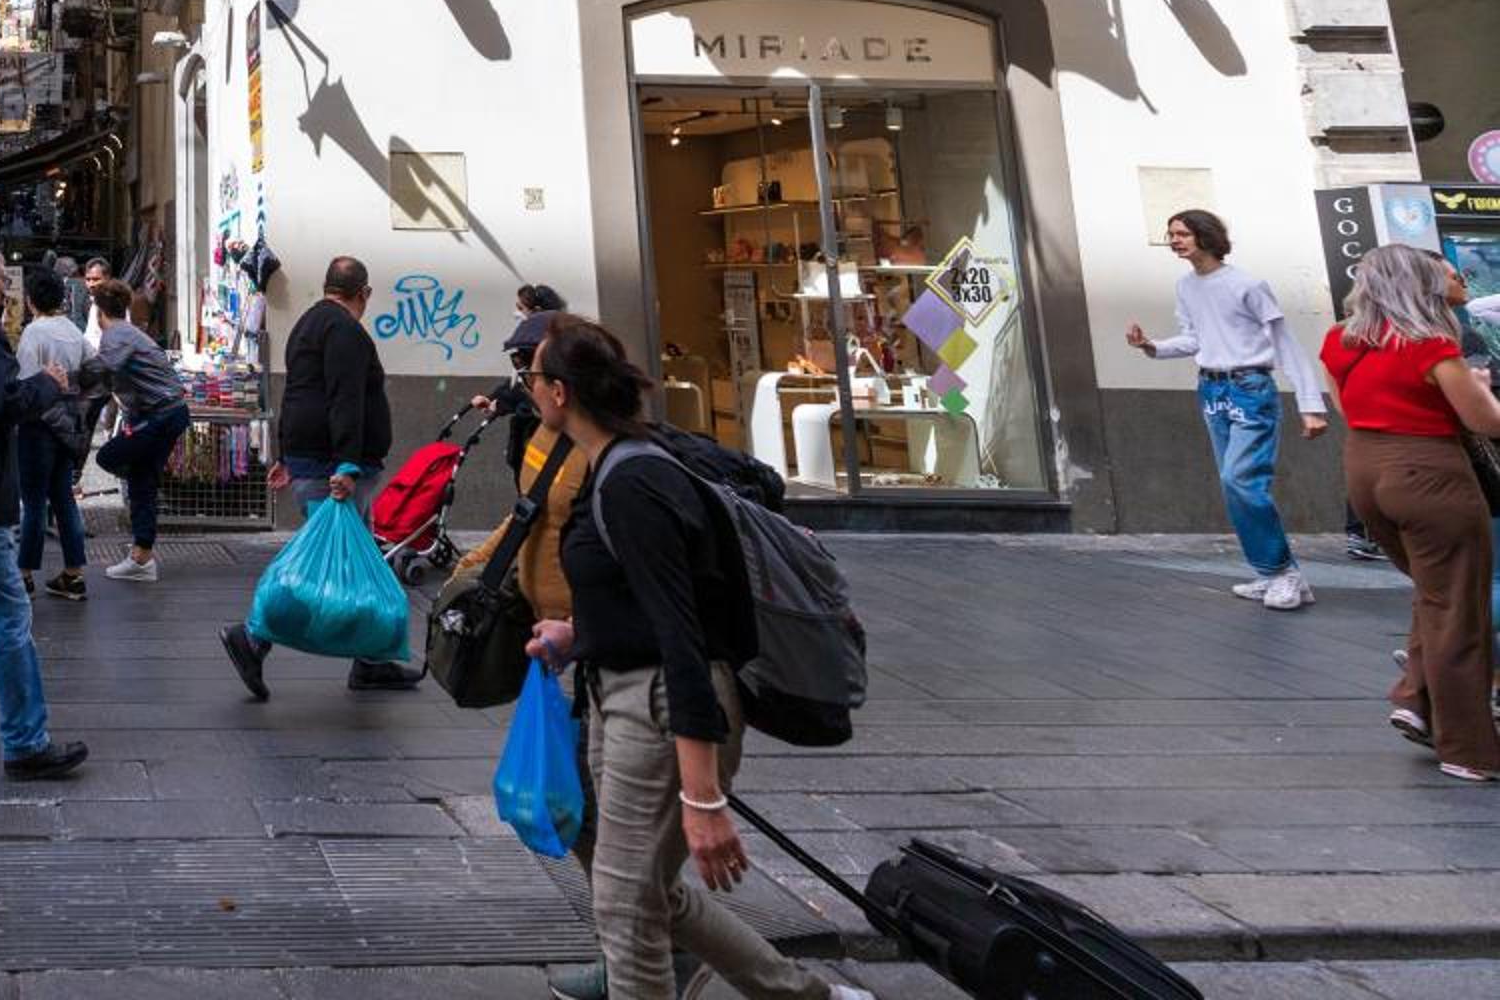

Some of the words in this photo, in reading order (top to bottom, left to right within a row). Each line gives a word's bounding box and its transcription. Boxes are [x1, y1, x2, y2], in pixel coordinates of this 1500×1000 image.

[694, 34, 932, 62] MIRIADE
[0, 57, 27, 70] BAR
[950, 268, 989, 285] 2x20
[951, 286, 992, 303] 3x30
